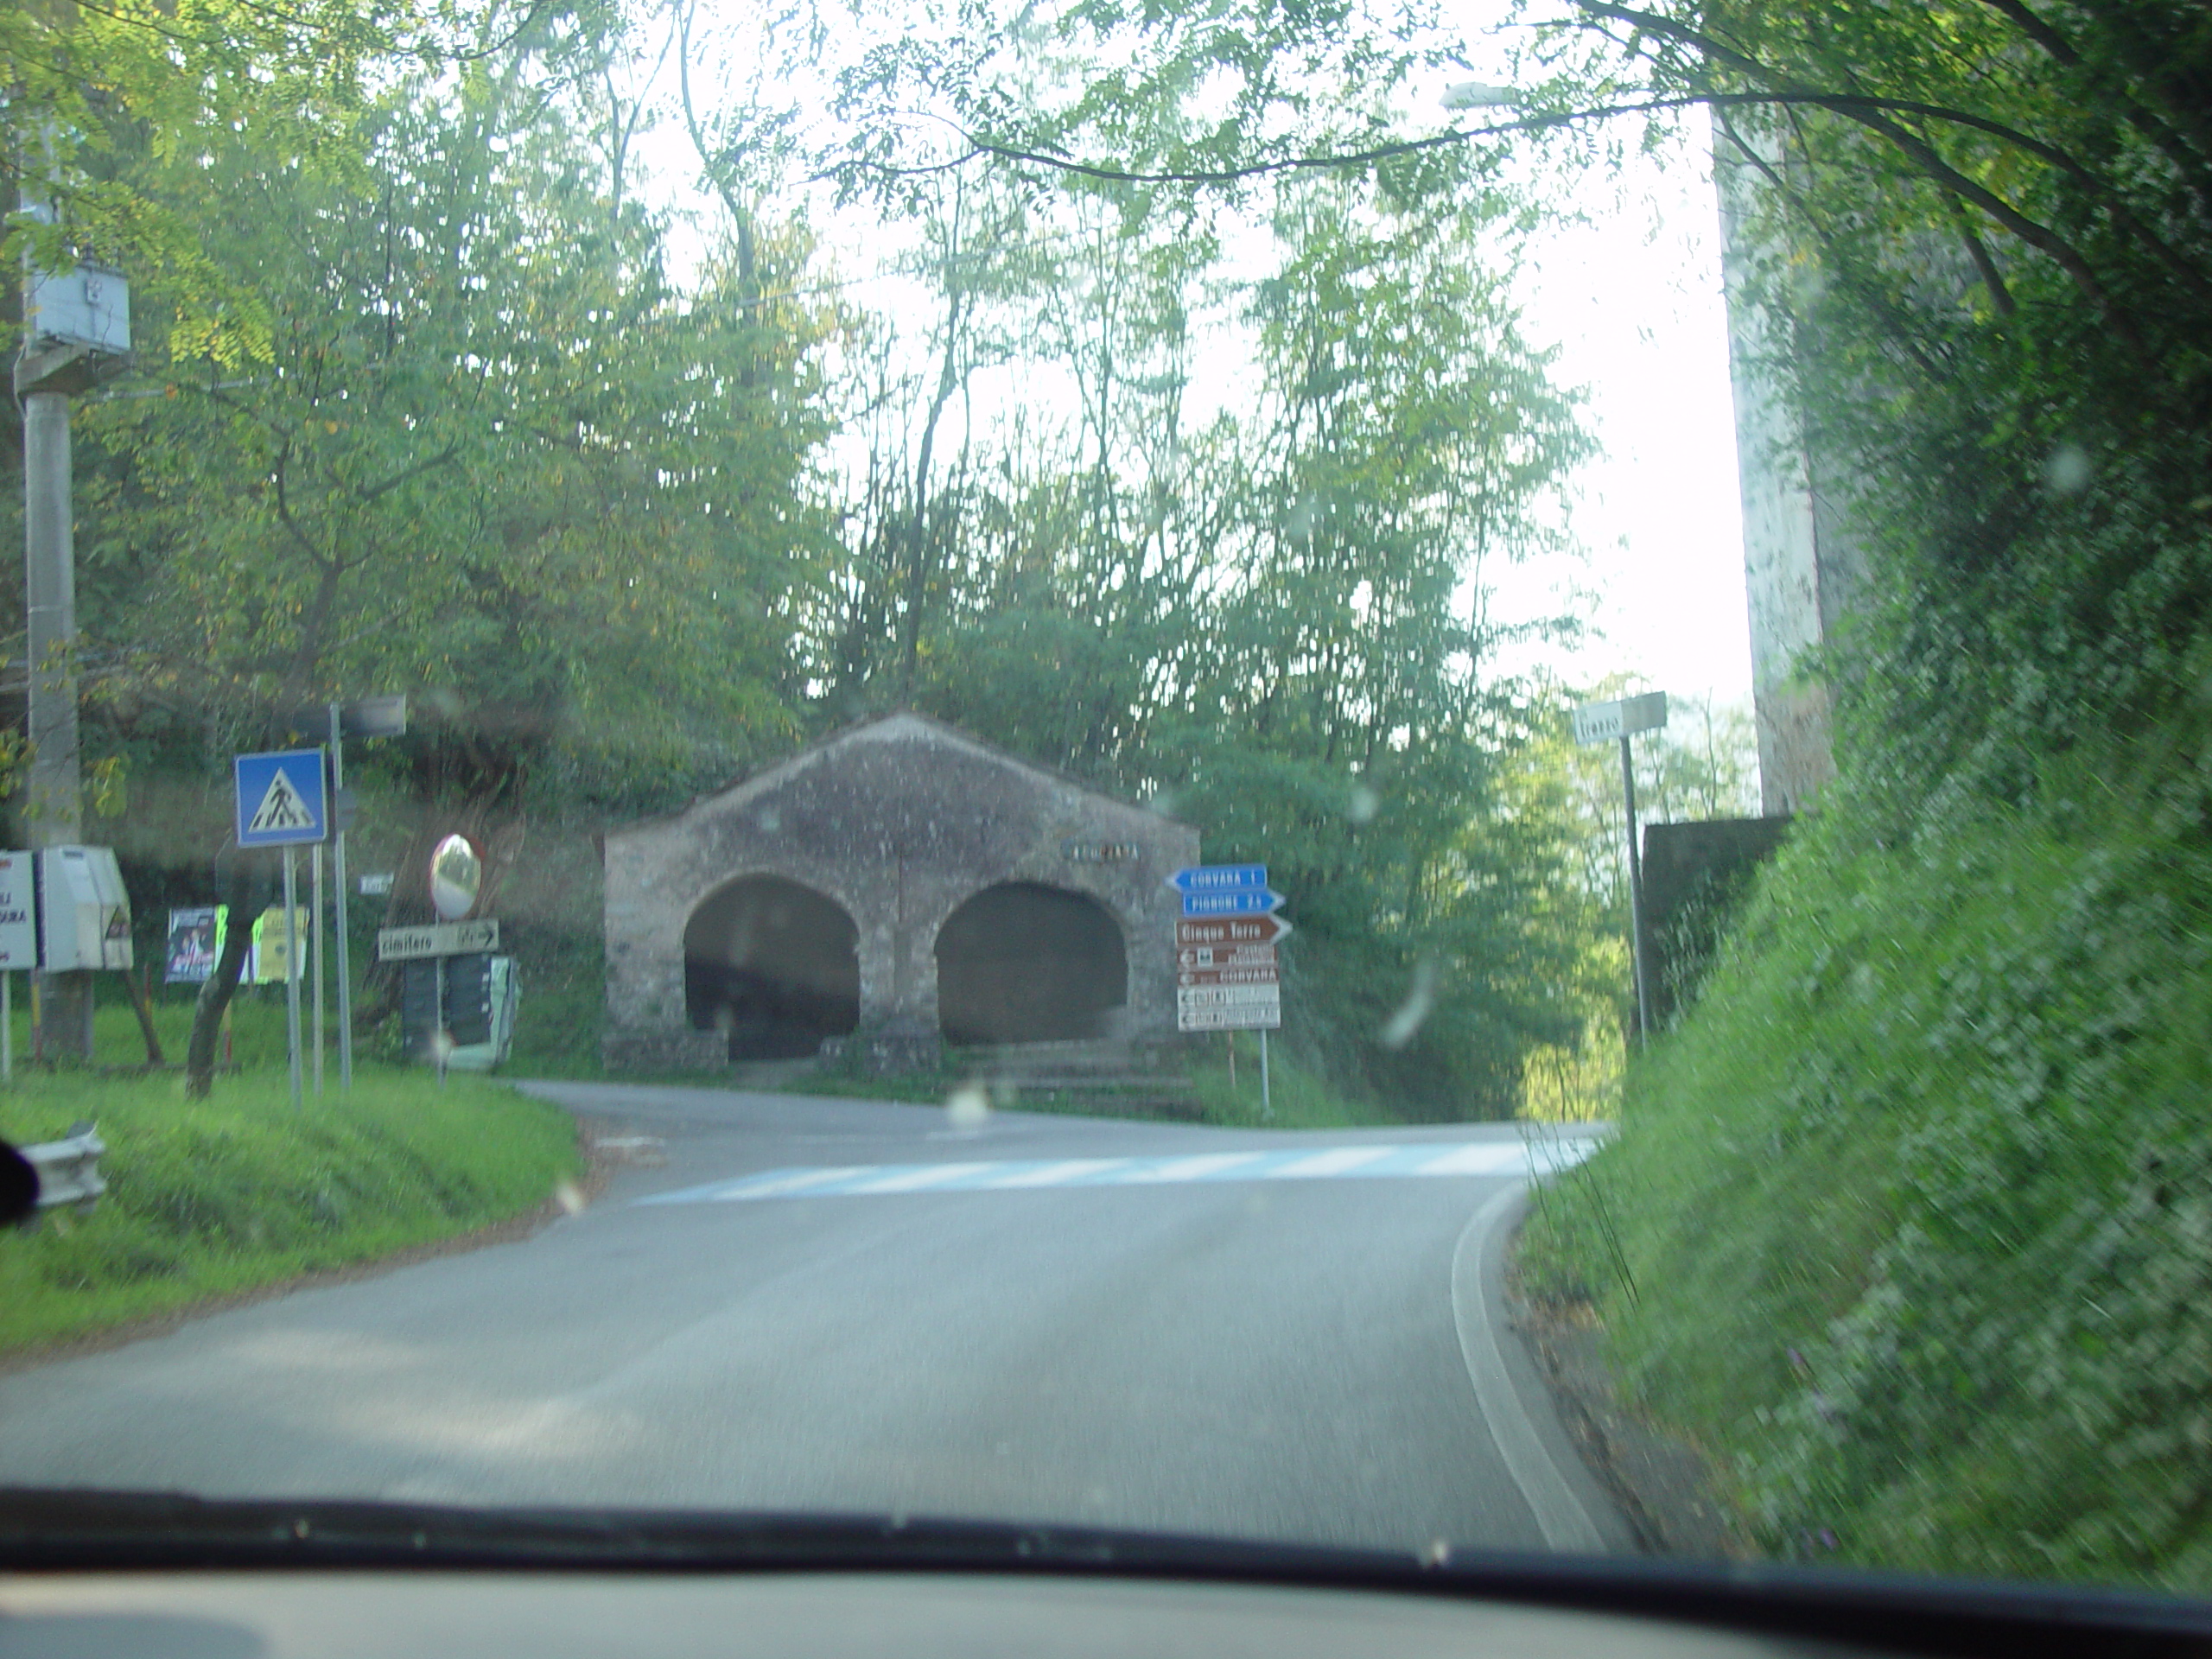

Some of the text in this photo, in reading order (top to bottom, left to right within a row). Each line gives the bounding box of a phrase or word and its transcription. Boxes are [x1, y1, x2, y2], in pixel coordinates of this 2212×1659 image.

[1190, 869, 1241, 888] CORVARA
[1192, 894, 1237, 912] PIGNONE
[1182, 920, 1261, 943] Cinque Terre
[1220, 966, 1276, 983] CORVARA
